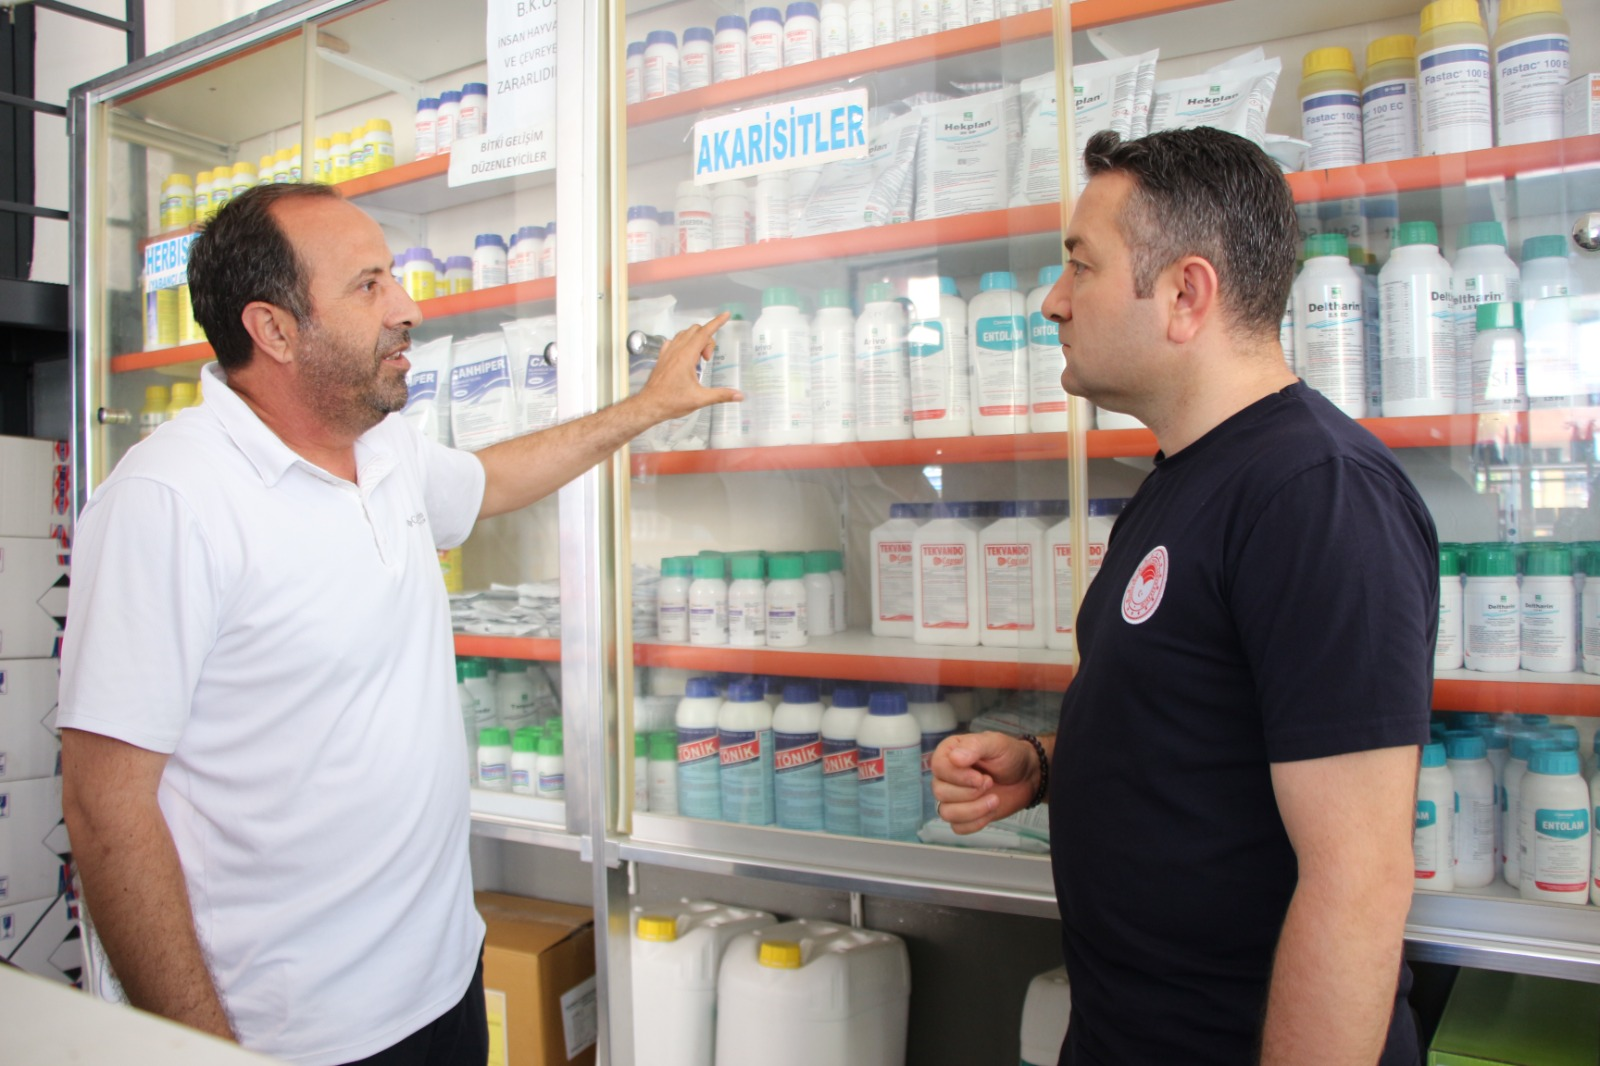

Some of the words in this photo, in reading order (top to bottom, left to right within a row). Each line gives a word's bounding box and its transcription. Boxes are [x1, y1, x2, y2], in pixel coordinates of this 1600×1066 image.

[497, 31, 525, 48] İNSAN
[527, 20, 557, 39] HAYVA
[504, 56, 516, 68] VE
[1502, 62, 1537, 77] Fastac
[1544, 59, 1561, 69] 100
[1425, 70, 1459, 85] Fastac
[1466, 69, 1482, 78] 100
[1051, 94, 1101, 106] Hplan
[1187, 93, 1238, 106] Hekplan
[1373, 105, 1387, 114] 100
[1390, 102, 1403, 111] EC
[1306, 113, 1336, 125] Fastac
[1342, 112, 1355, 120] 100
[944, 119, 991, 132] Hekplan
[480, 133, 504, 153] BİTKİ
[505, 129, 544, 147] GELİŞİM
[696, 104, 866, 175] AKARİSİTLER
[471, 150, 547, 174] DÜZENLEYİCİLER
[1453, 291, 1501, 305] eltharin
[1308, 302, 1360, 312] Deltharin
[983, 330, 1023, 342] ENTOLAM
[1033, 323, 1058, 337] ENTOL
[880, 543, 912, 553] TEKVAND
[923, 546, 963, 556] TEKVANDO
[987, 546, 1029, 556] TEKVANDO
[824, 754, 856, 773] ONİK
[858, 763, 878, 779] NİK
[1542, 819, 1584, 831] ENTOLAM
